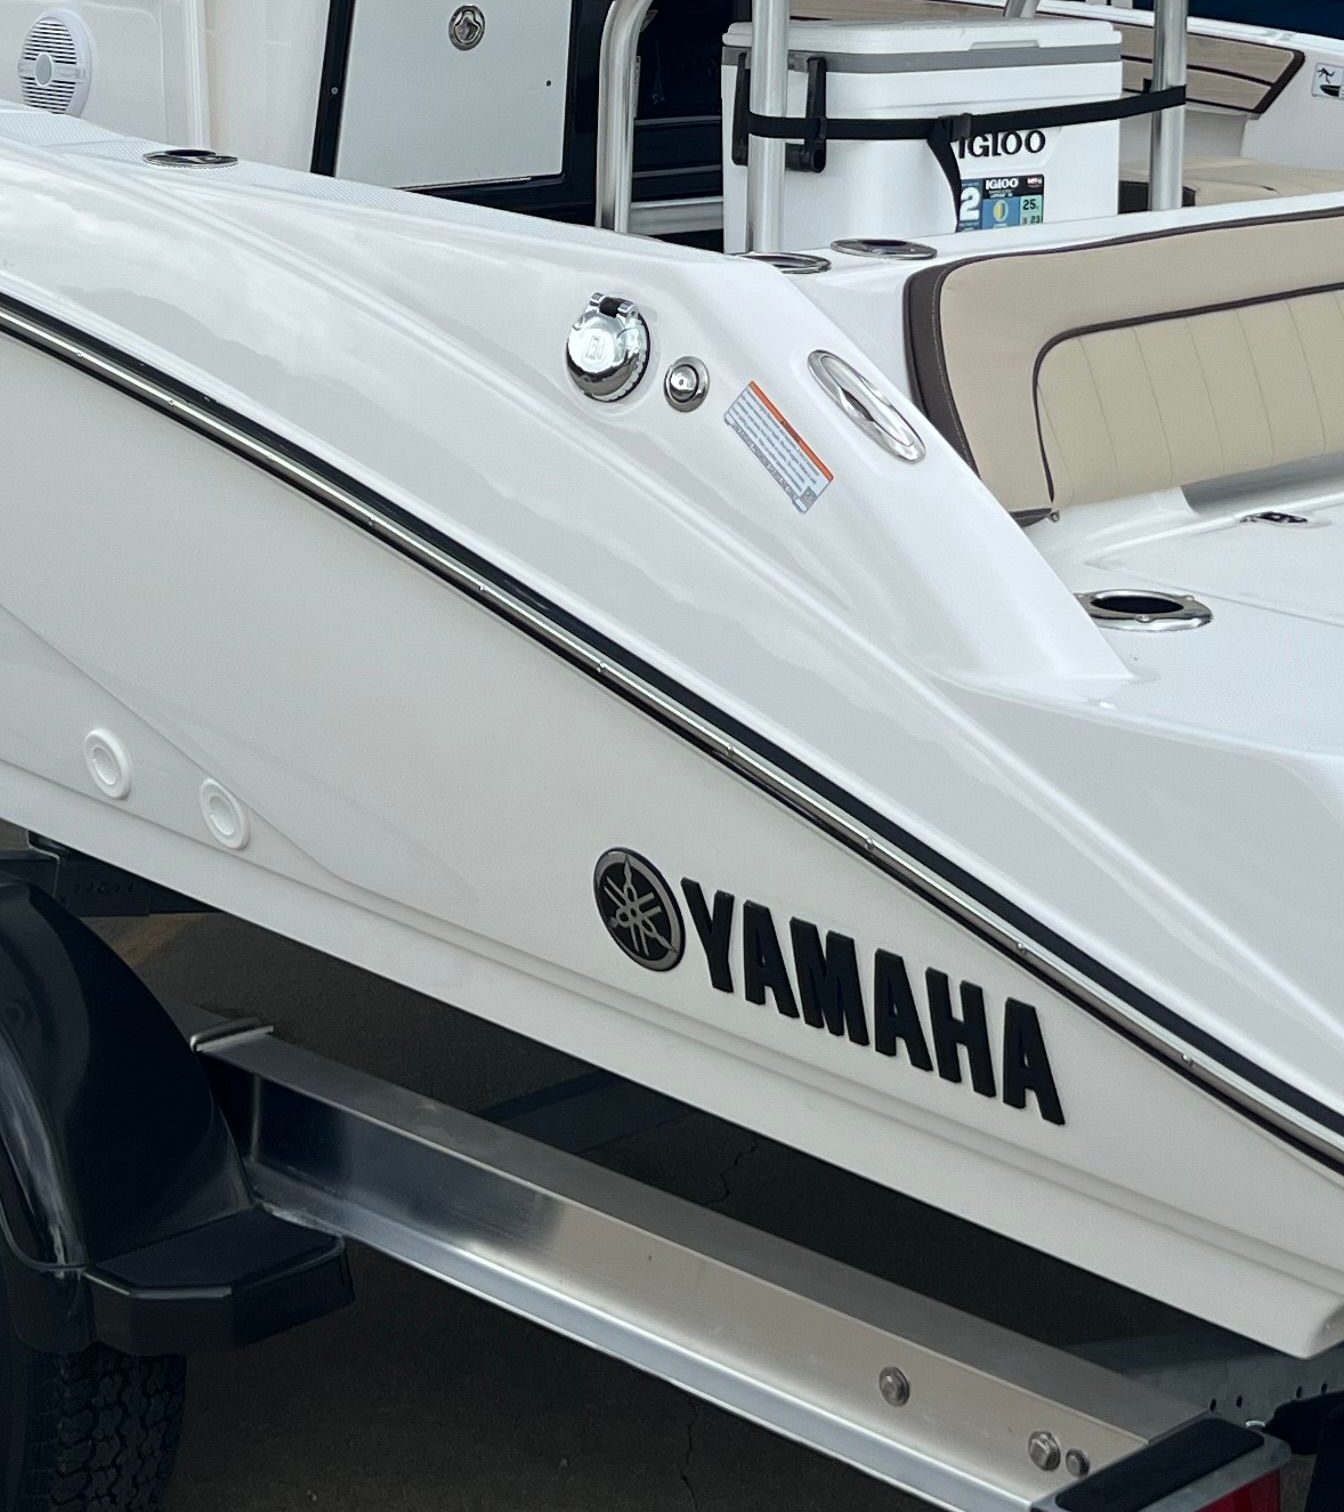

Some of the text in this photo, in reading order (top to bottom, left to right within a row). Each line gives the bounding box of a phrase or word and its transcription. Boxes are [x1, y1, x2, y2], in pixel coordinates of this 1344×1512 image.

[958, 130, 1046, 159] IGLOO
[986, 177, 1019, 190] IGLOO
[680, 876, 1066, 1126] YAMAHA
